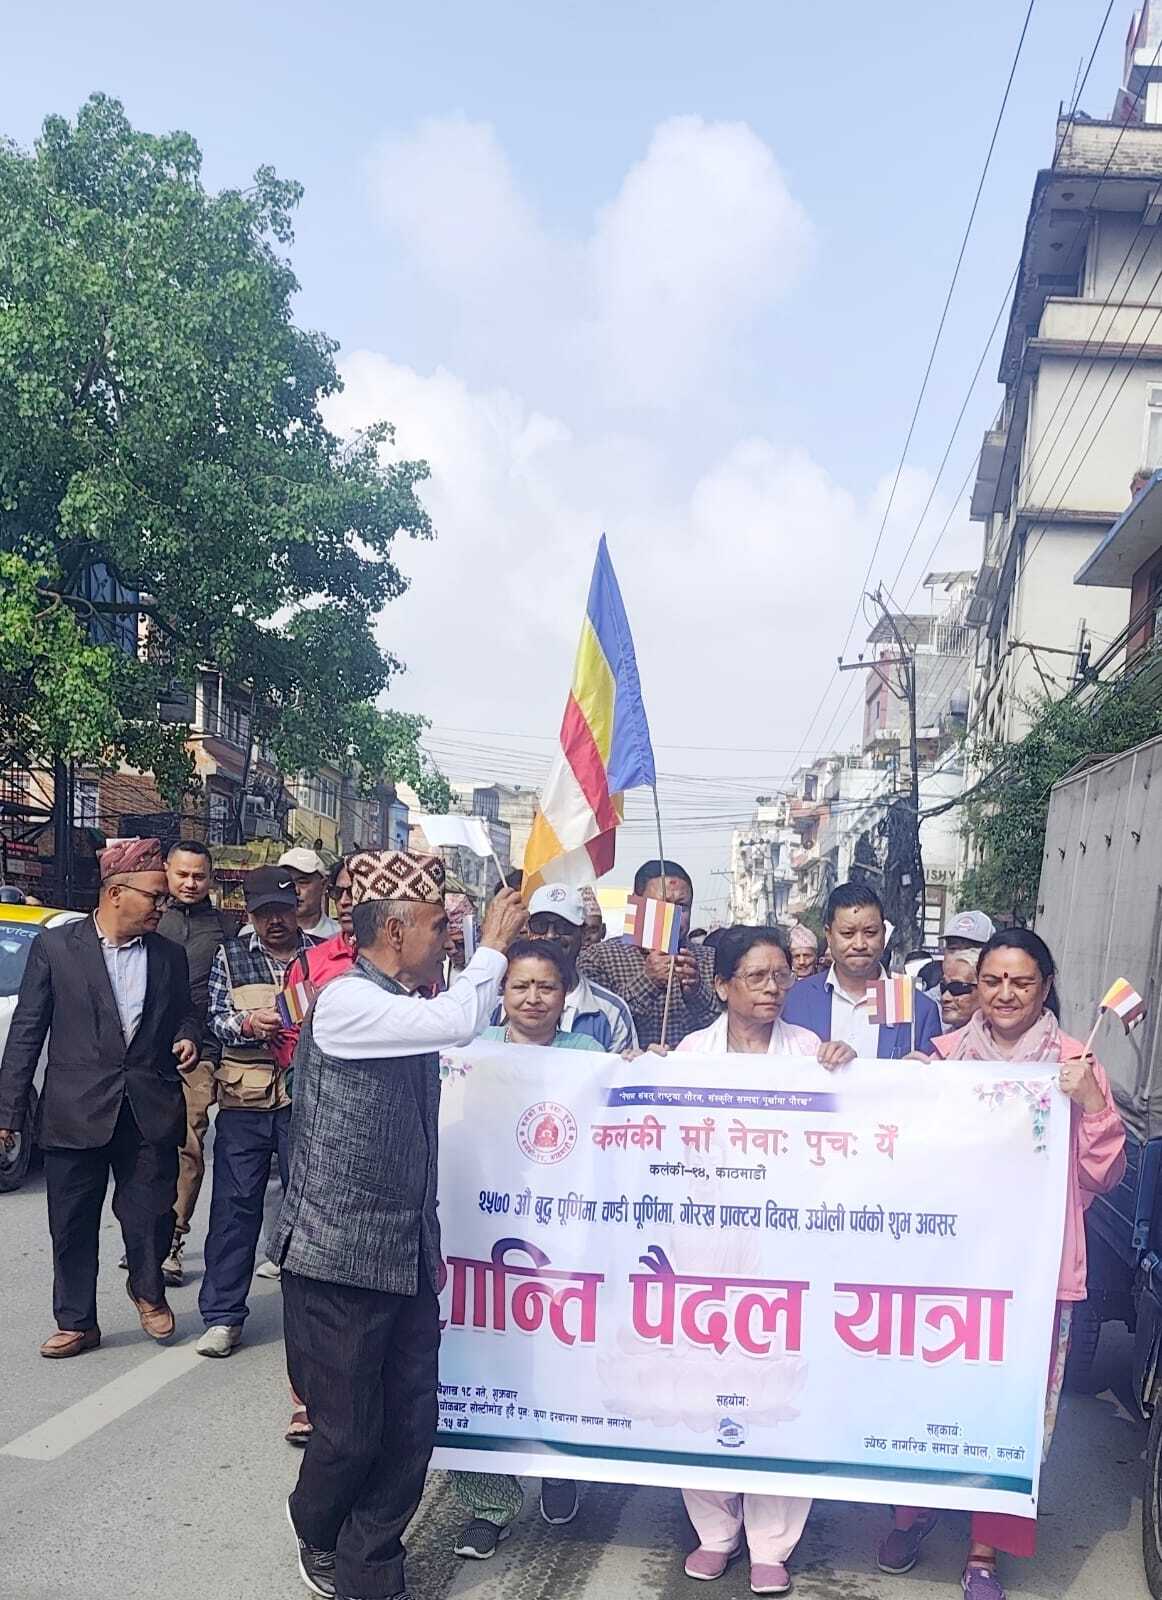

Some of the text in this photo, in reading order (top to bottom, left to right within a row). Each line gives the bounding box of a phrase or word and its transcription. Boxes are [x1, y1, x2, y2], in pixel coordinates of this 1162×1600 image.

[591, 1115, 666, 1152] कलंकी
[479, 1190, 510, 1215] २५७०
[535, 1196, 554, 1225] बुद्ध
[602, 1195, 629, 1222] चण्डी
[680, 1196, 715, 1226] गोरख
[849, 1204, 884, 1232] पर्वको
[888, 1212, 911, 1240] शुभ
[916, 1213, 958, 1236] अवसर
[628, 1244, 809, 1355] पैदल
[833, 1282, 1014, 1362] यात्रा
[891, 1437, 928, 1454] नागरिक
[931, 1442, 959, 1455] समाज
[996, 1446, 1025, 1461] कलंकी
